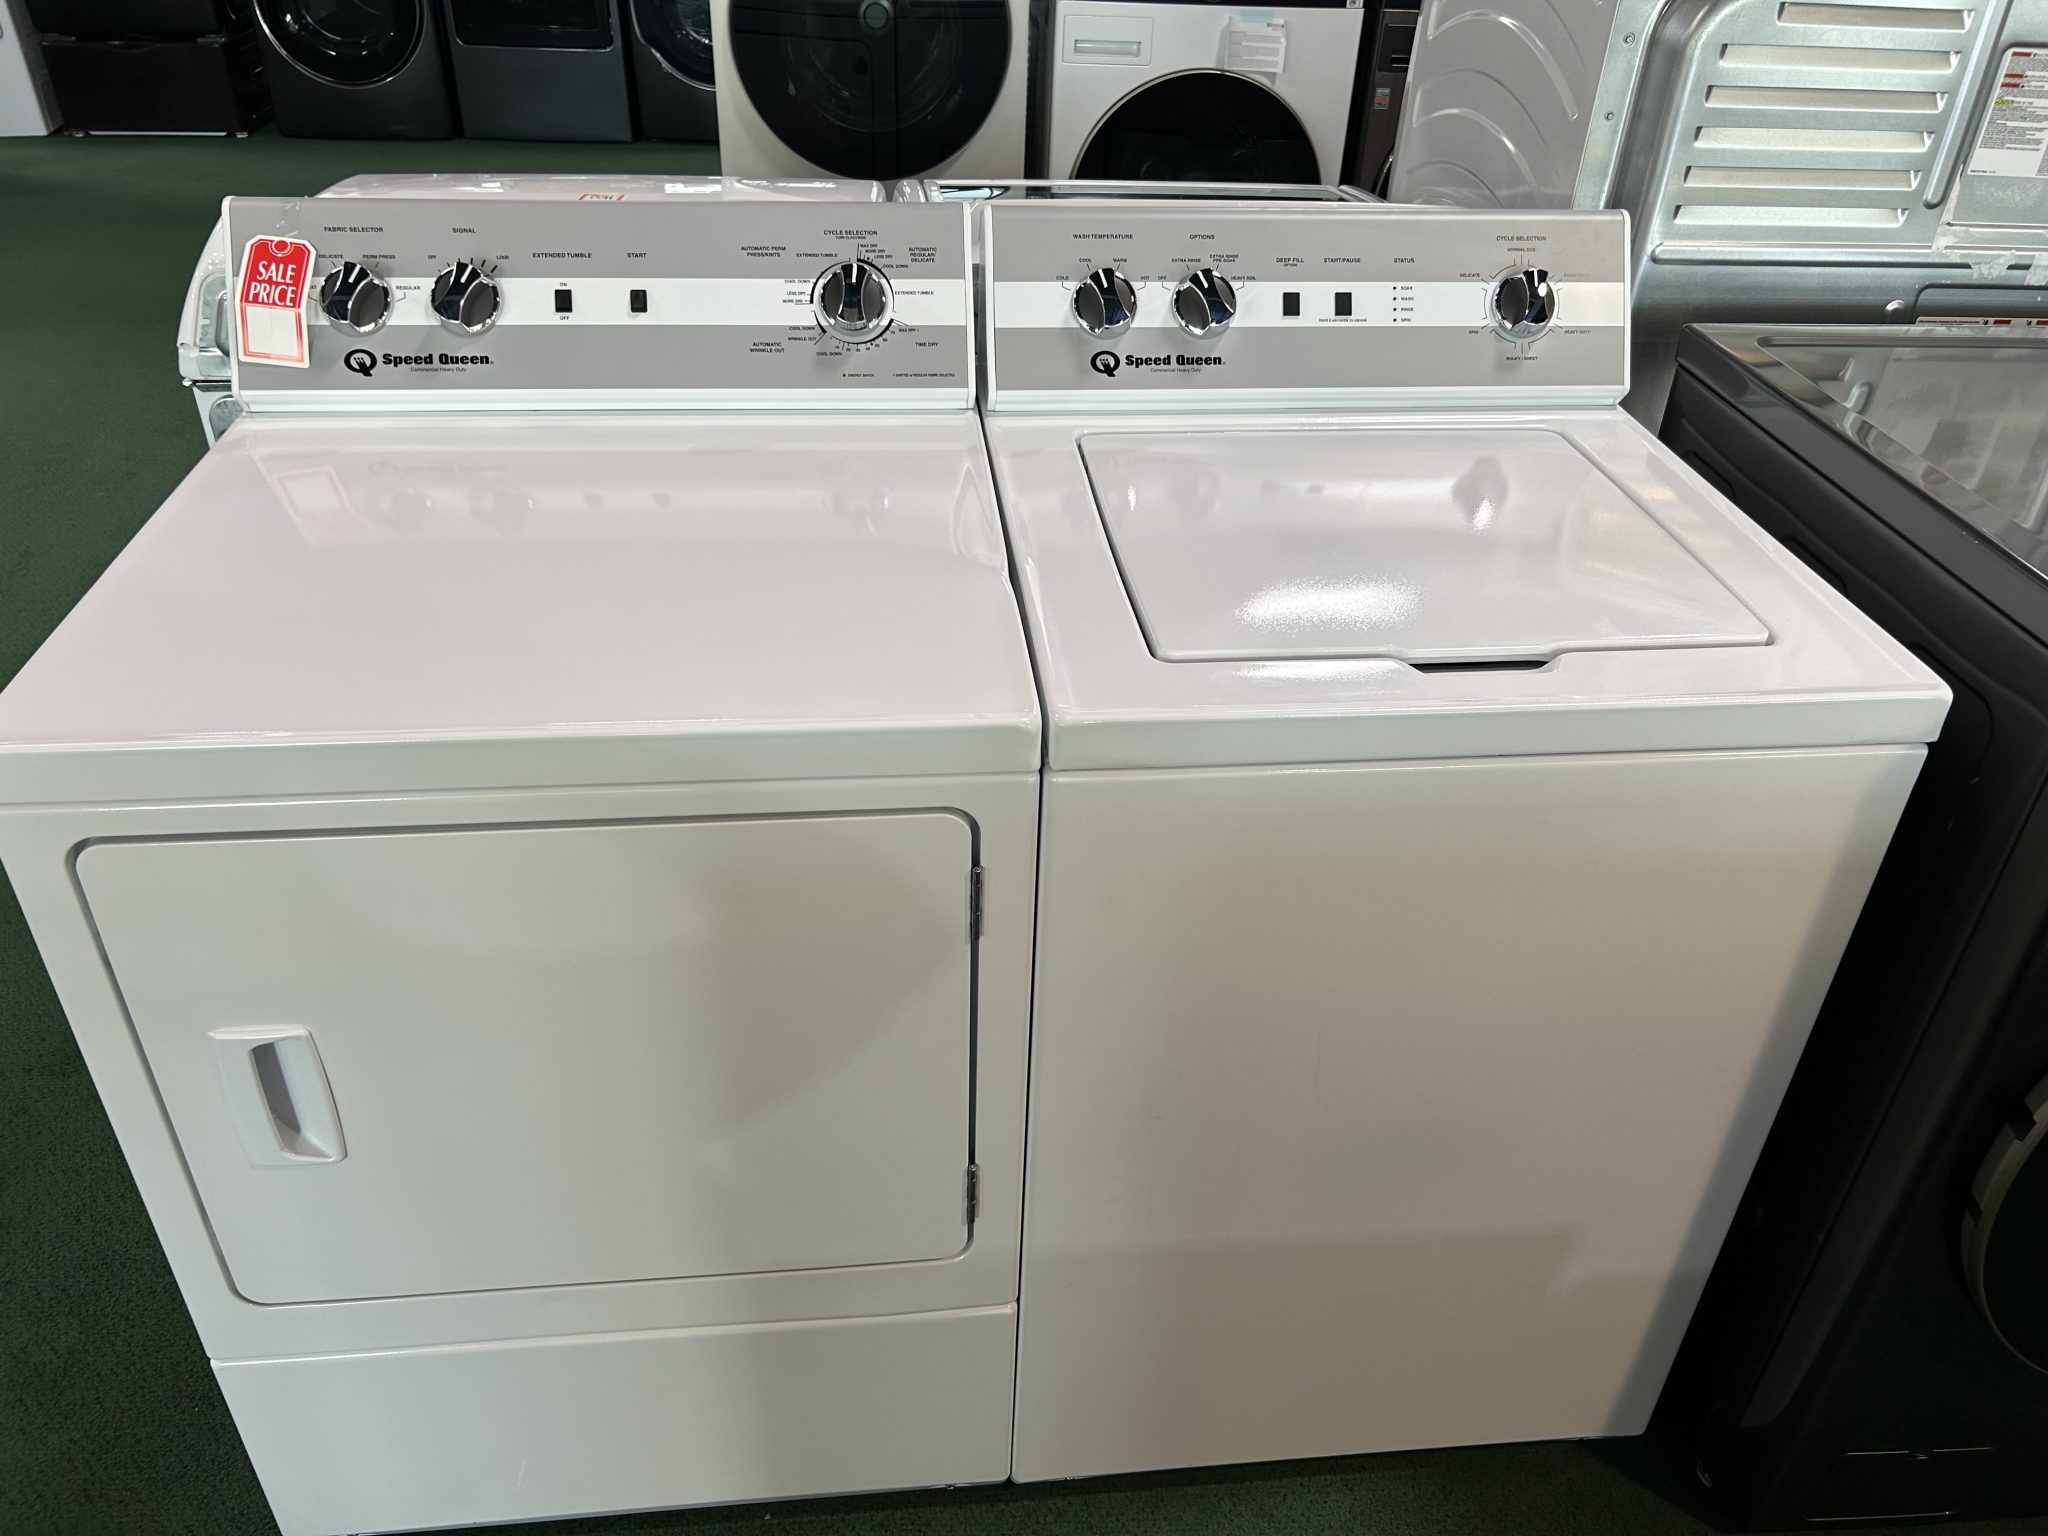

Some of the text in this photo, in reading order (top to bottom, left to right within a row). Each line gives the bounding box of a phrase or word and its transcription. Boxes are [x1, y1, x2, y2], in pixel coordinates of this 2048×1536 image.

[256, 260, 297, 284] SALE
[248, 282, 296, 307] PRICE
[382, 353, 434, 368] Speed
[1125, 354, 1171, 368] Speed
